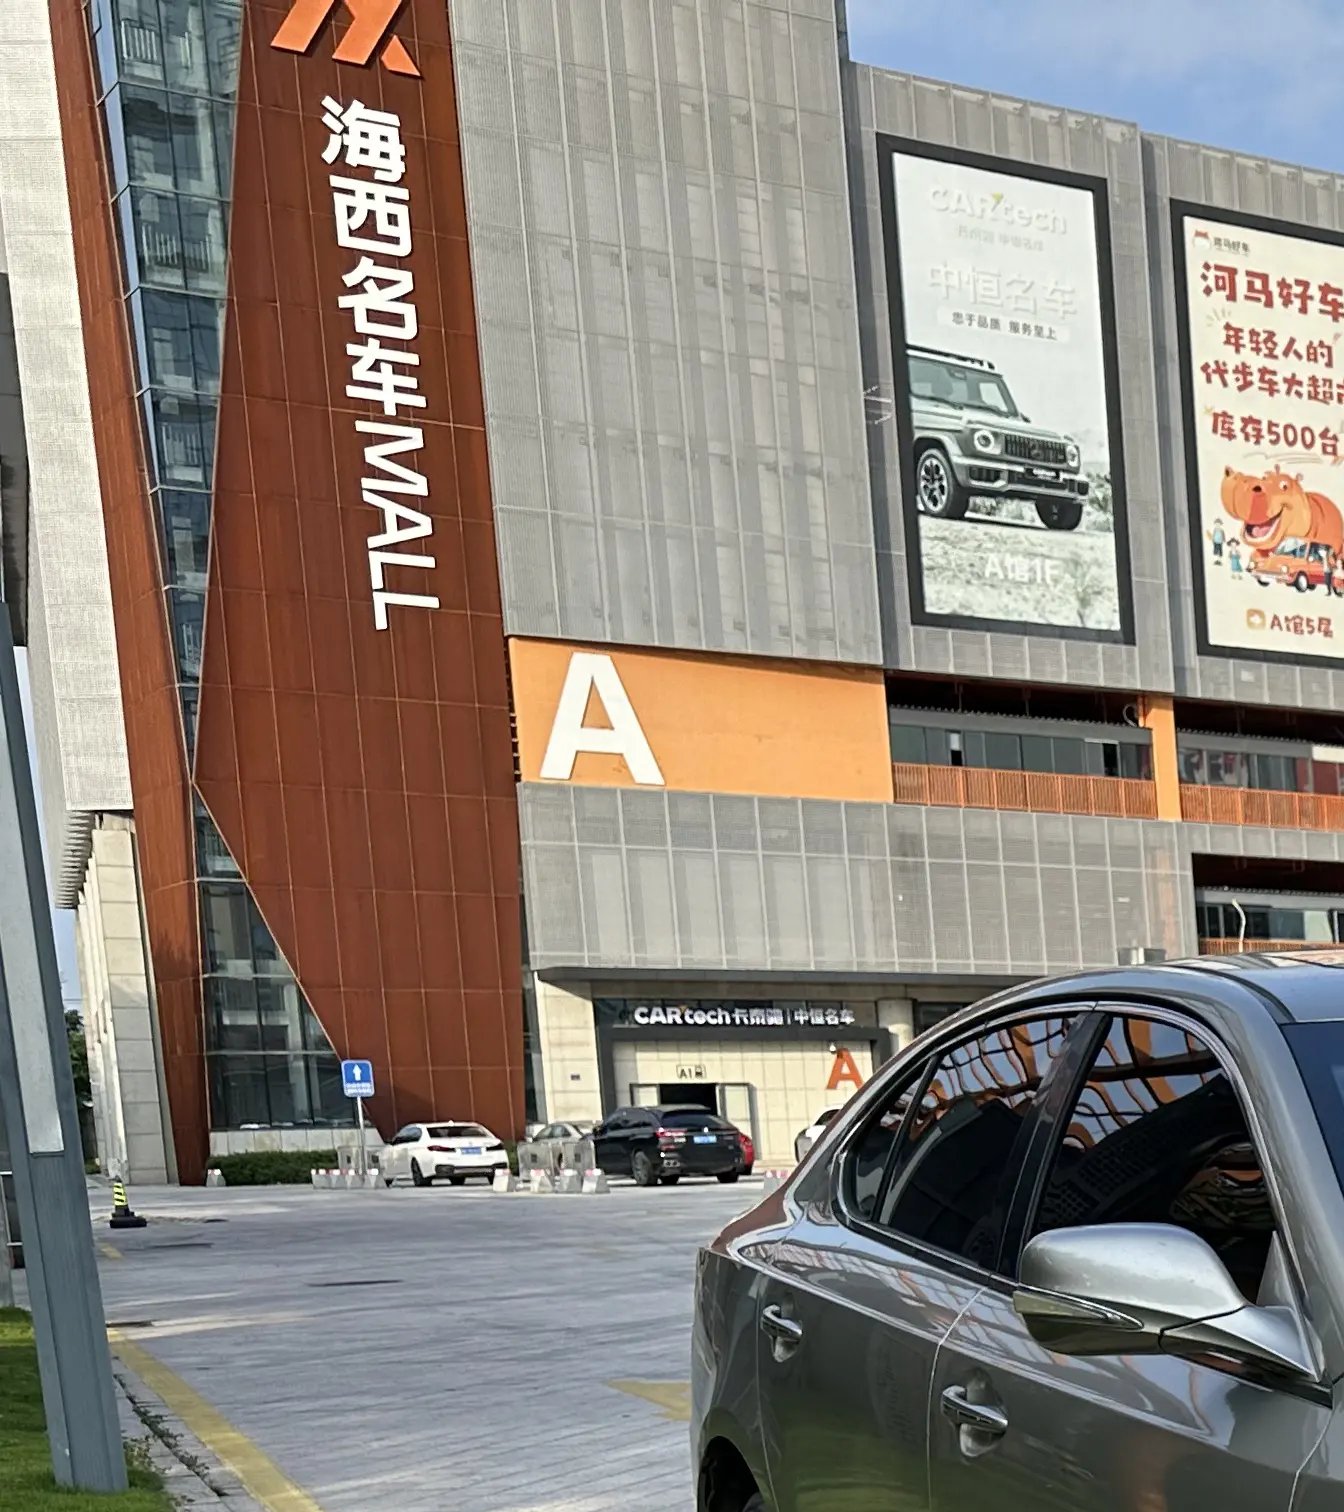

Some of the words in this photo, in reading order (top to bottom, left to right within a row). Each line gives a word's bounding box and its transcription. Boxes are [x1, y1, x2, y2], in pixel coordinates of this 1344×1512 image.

[320, 95, 440, 631] 海西名车MALL
[1223, 321, 1334, 369] 年轻人的
[539, 651, 667, 786] A
[634, 1005, 731, 1026] CARtech
[826, 1047, 866, 1090] A
